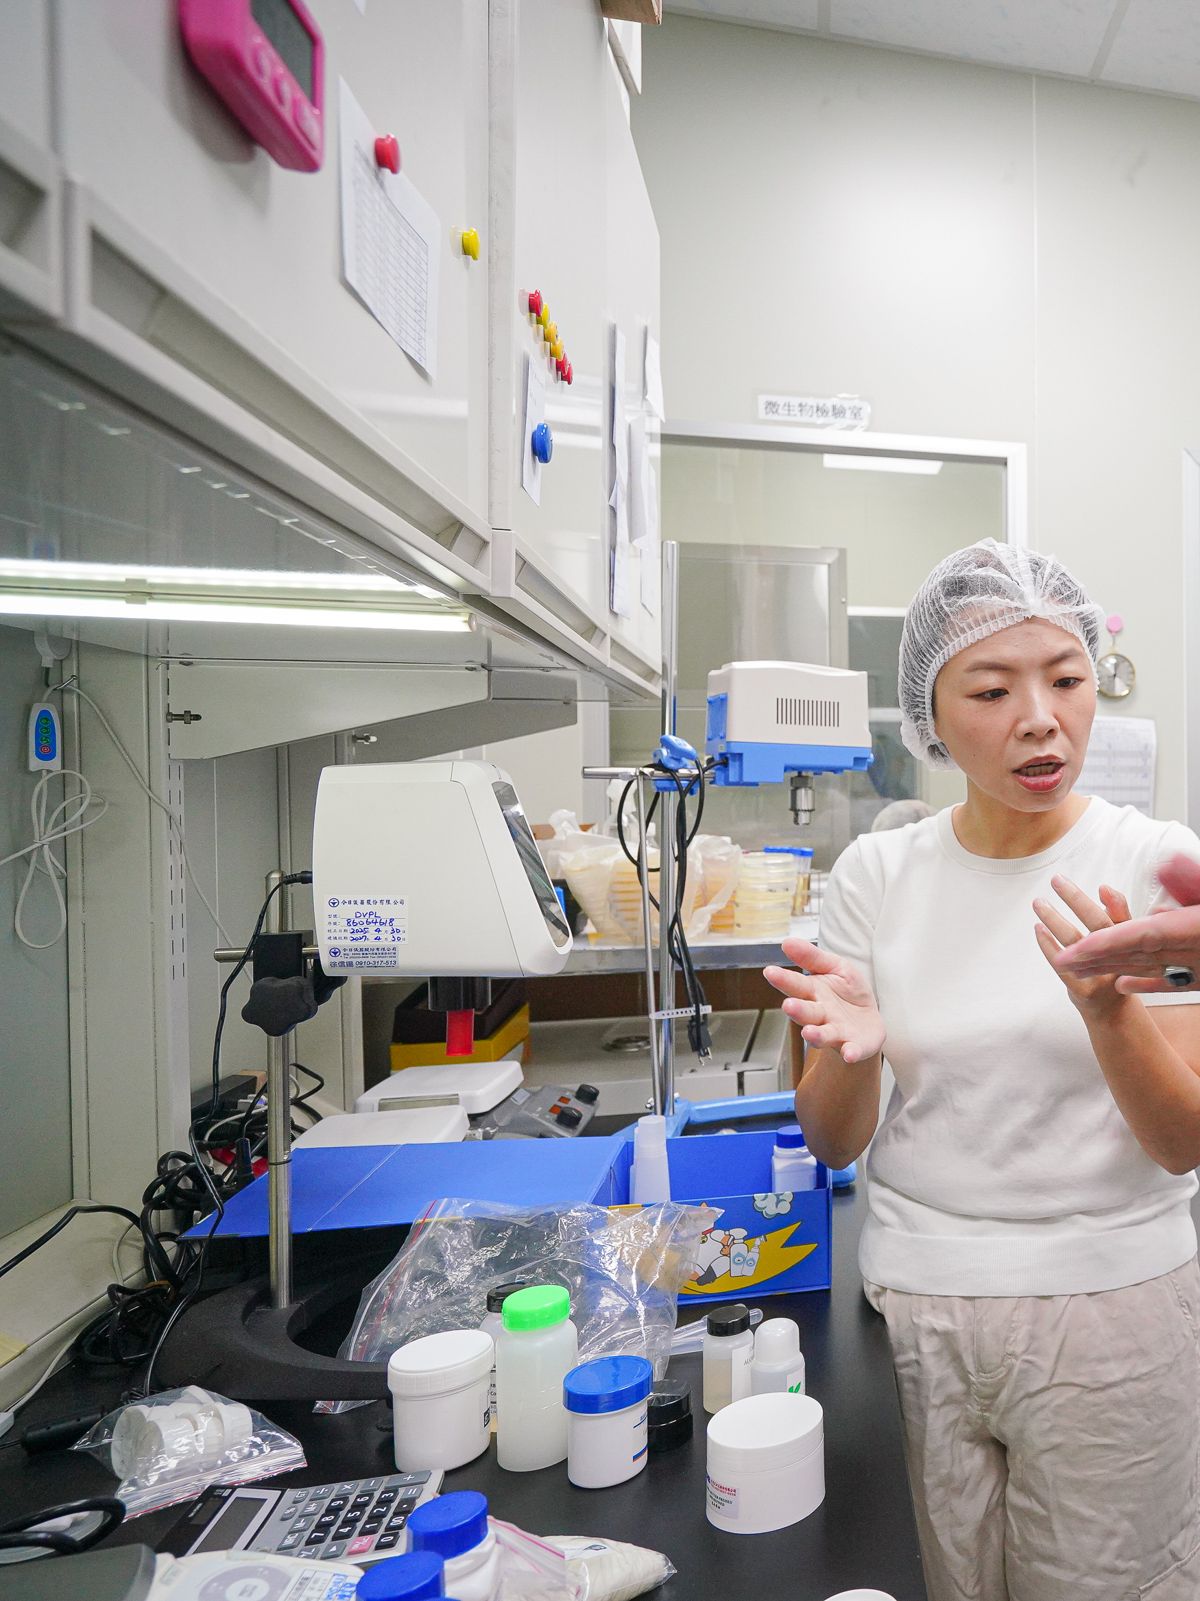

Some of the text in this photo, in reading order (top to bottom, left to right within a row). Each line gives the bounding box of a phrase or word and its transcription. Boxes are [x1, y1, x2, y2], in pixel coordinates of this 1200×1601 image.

[764, 400, 863, 421] 微生物檢驗室
[354, 911, 381, 919] DVPL
